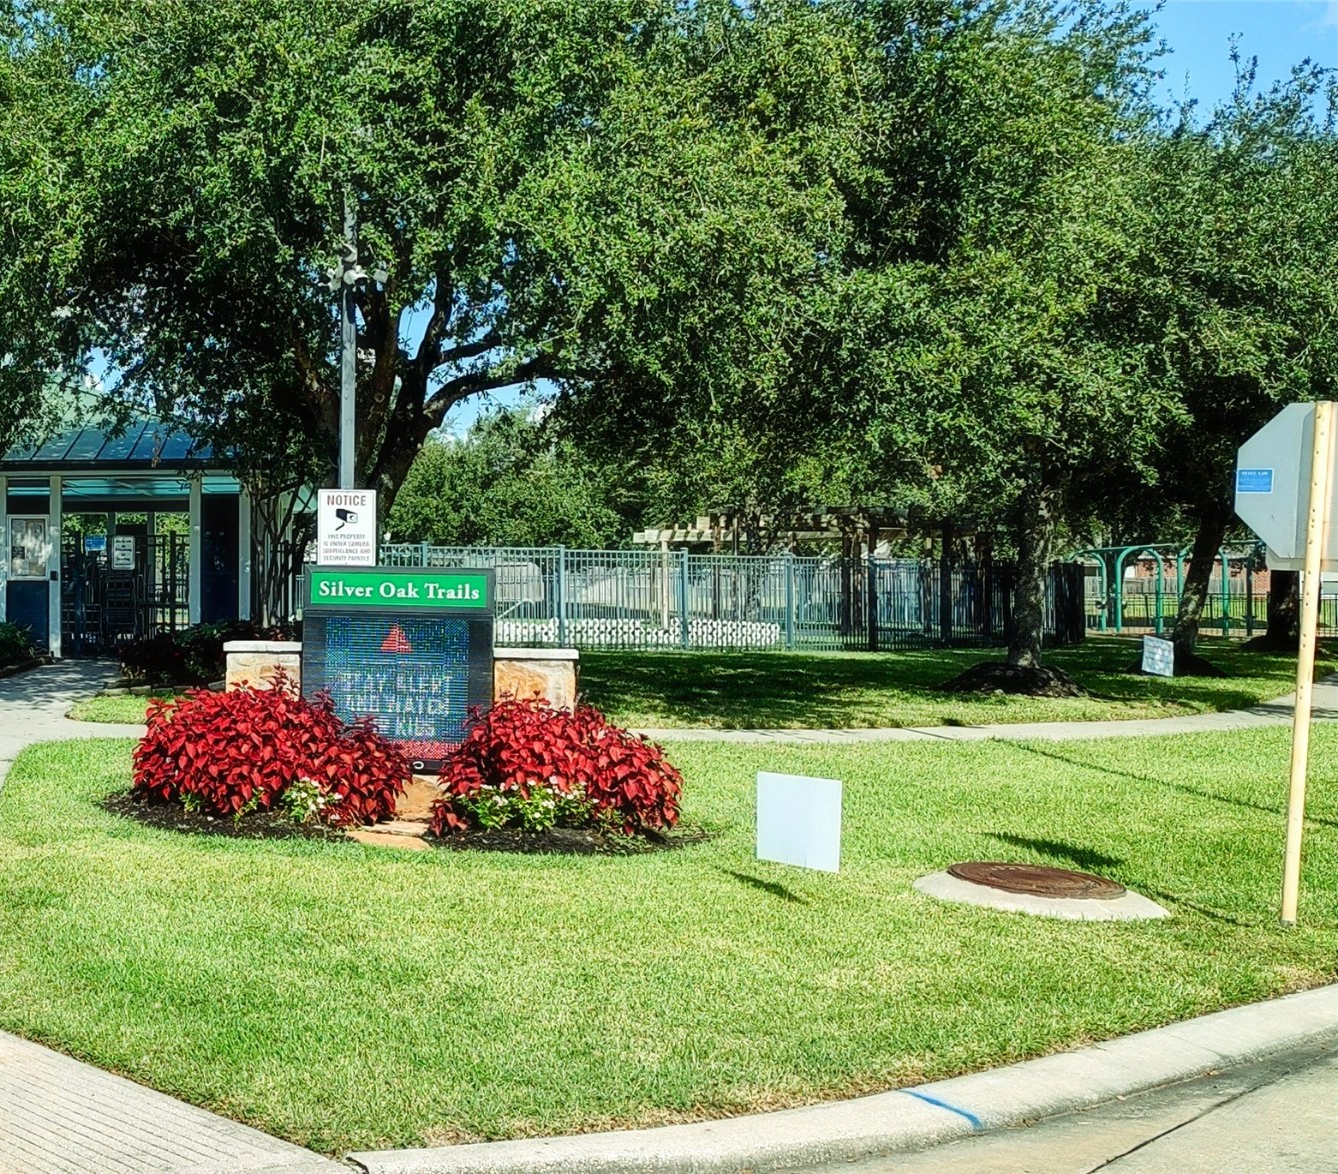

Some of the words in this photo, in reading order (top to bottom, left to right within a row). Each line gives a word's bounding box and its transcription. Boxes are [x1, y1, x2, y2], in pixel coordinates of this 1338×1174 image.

[327, 494, 367, 506] NOTICE
[318, 580, 374, 598] Silver
[379, 582, 420, 599] Oak
[424, 582, 480, 600] Trails
[395, 673, 453, 694] ALERT
[346, 694, 380, 712] AND
[384, 695, 450, 716] WATCH
[395, 717, 435, 736] KIDS
